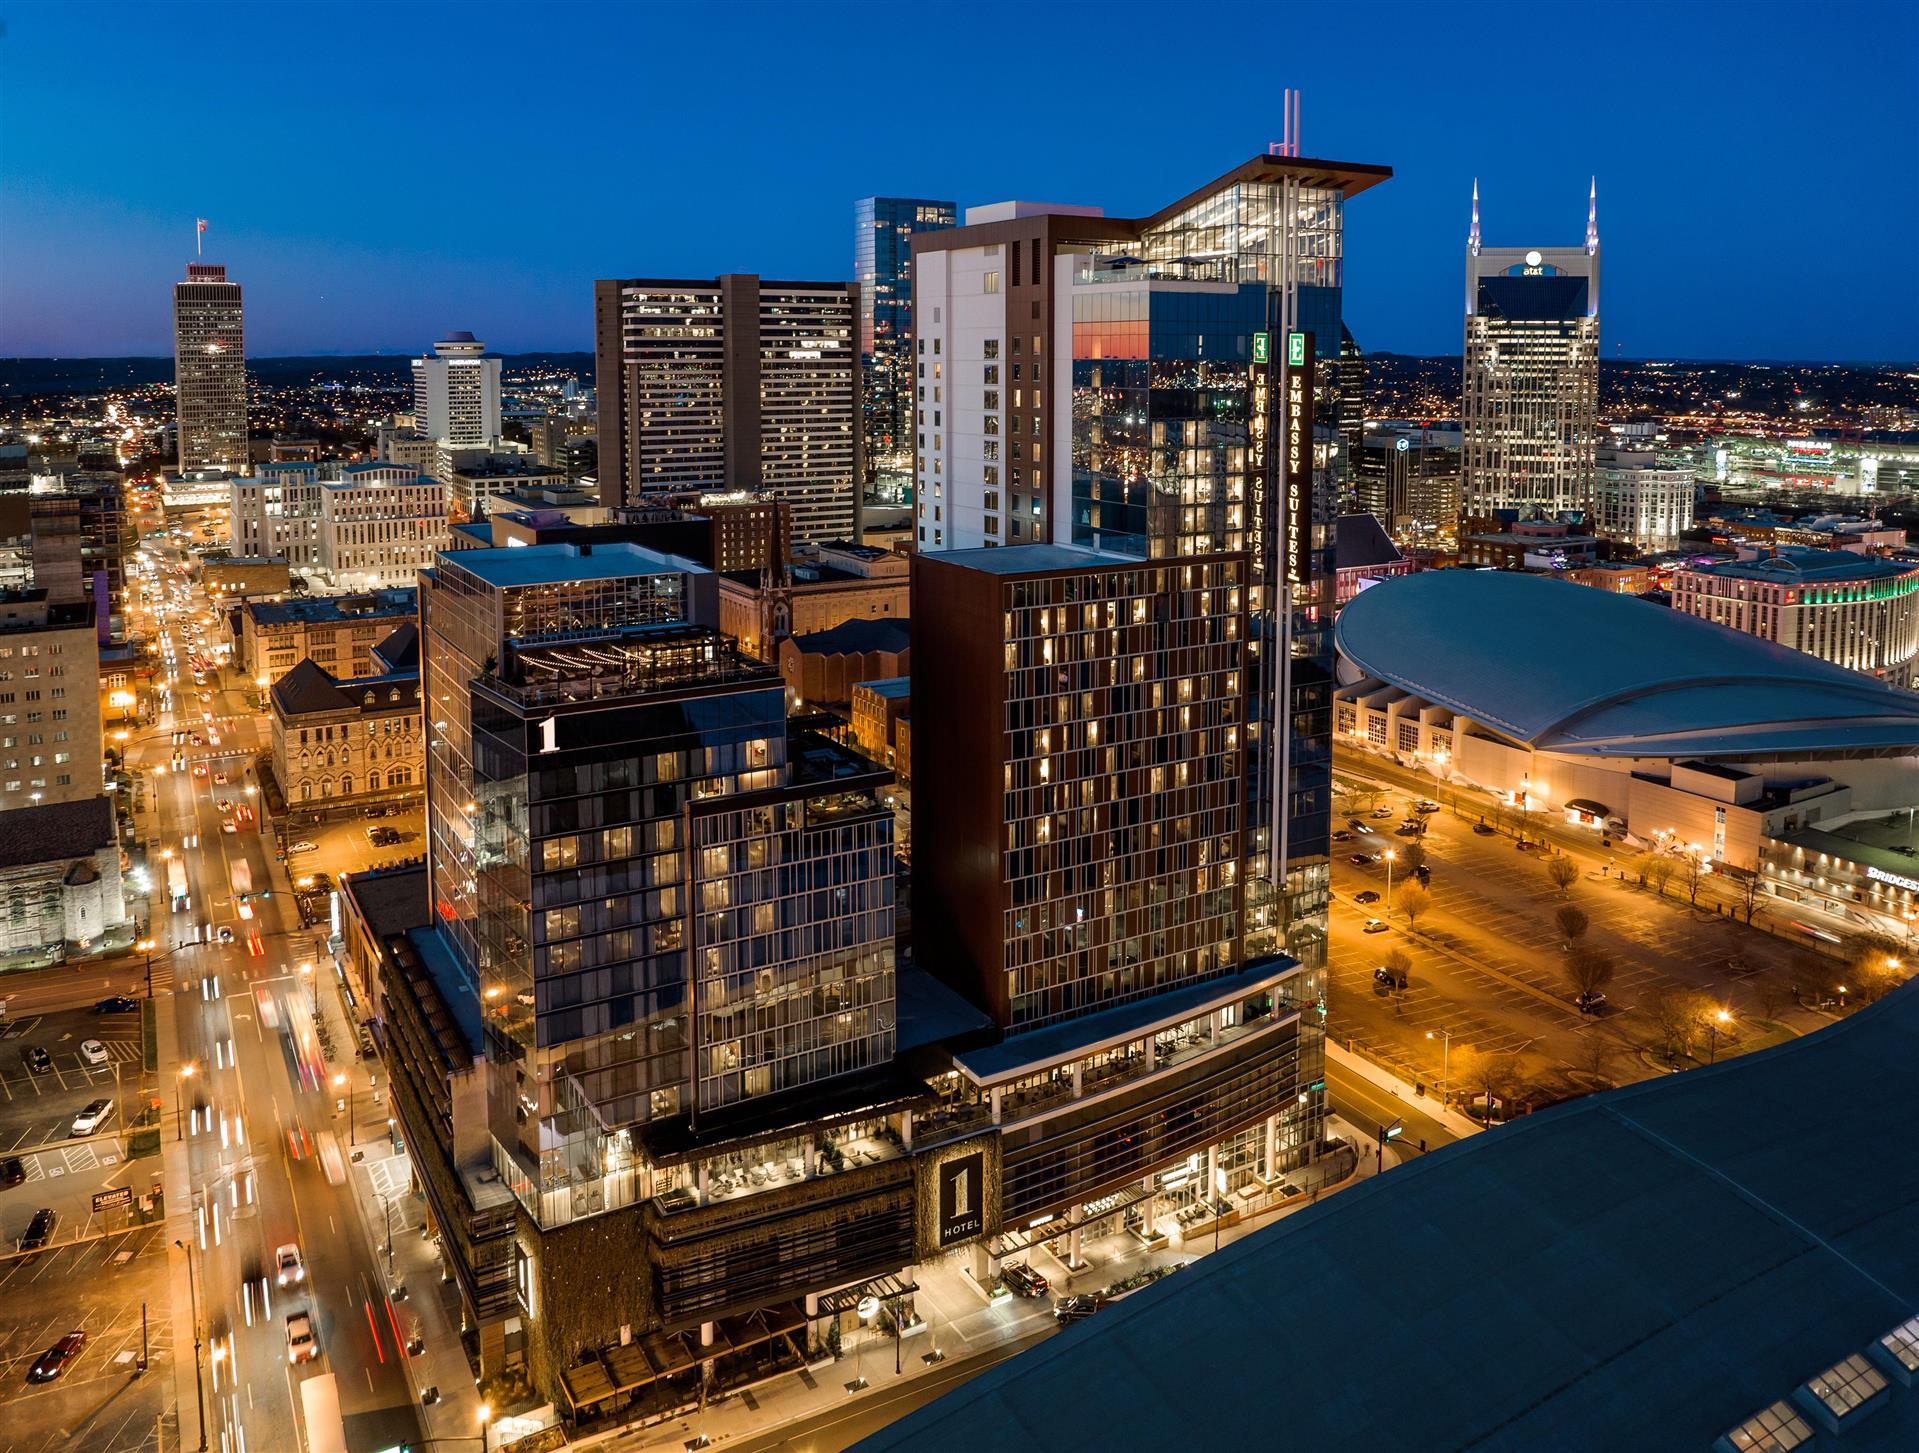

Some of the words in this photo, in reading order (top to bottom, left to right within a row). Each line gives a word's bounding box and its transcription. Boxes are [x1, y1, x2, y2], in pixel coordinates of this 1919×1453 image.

[1523, 267, 1543, 275] at&t
[1289, 375, 1303, 474] EMBASSY
[1288, 484, 1300, 567] SUITES
[538, 716, 560, 753] 1
[949, 1167, 974, 1219] 1
[944, 1219, 980, 1238] HOTEL
